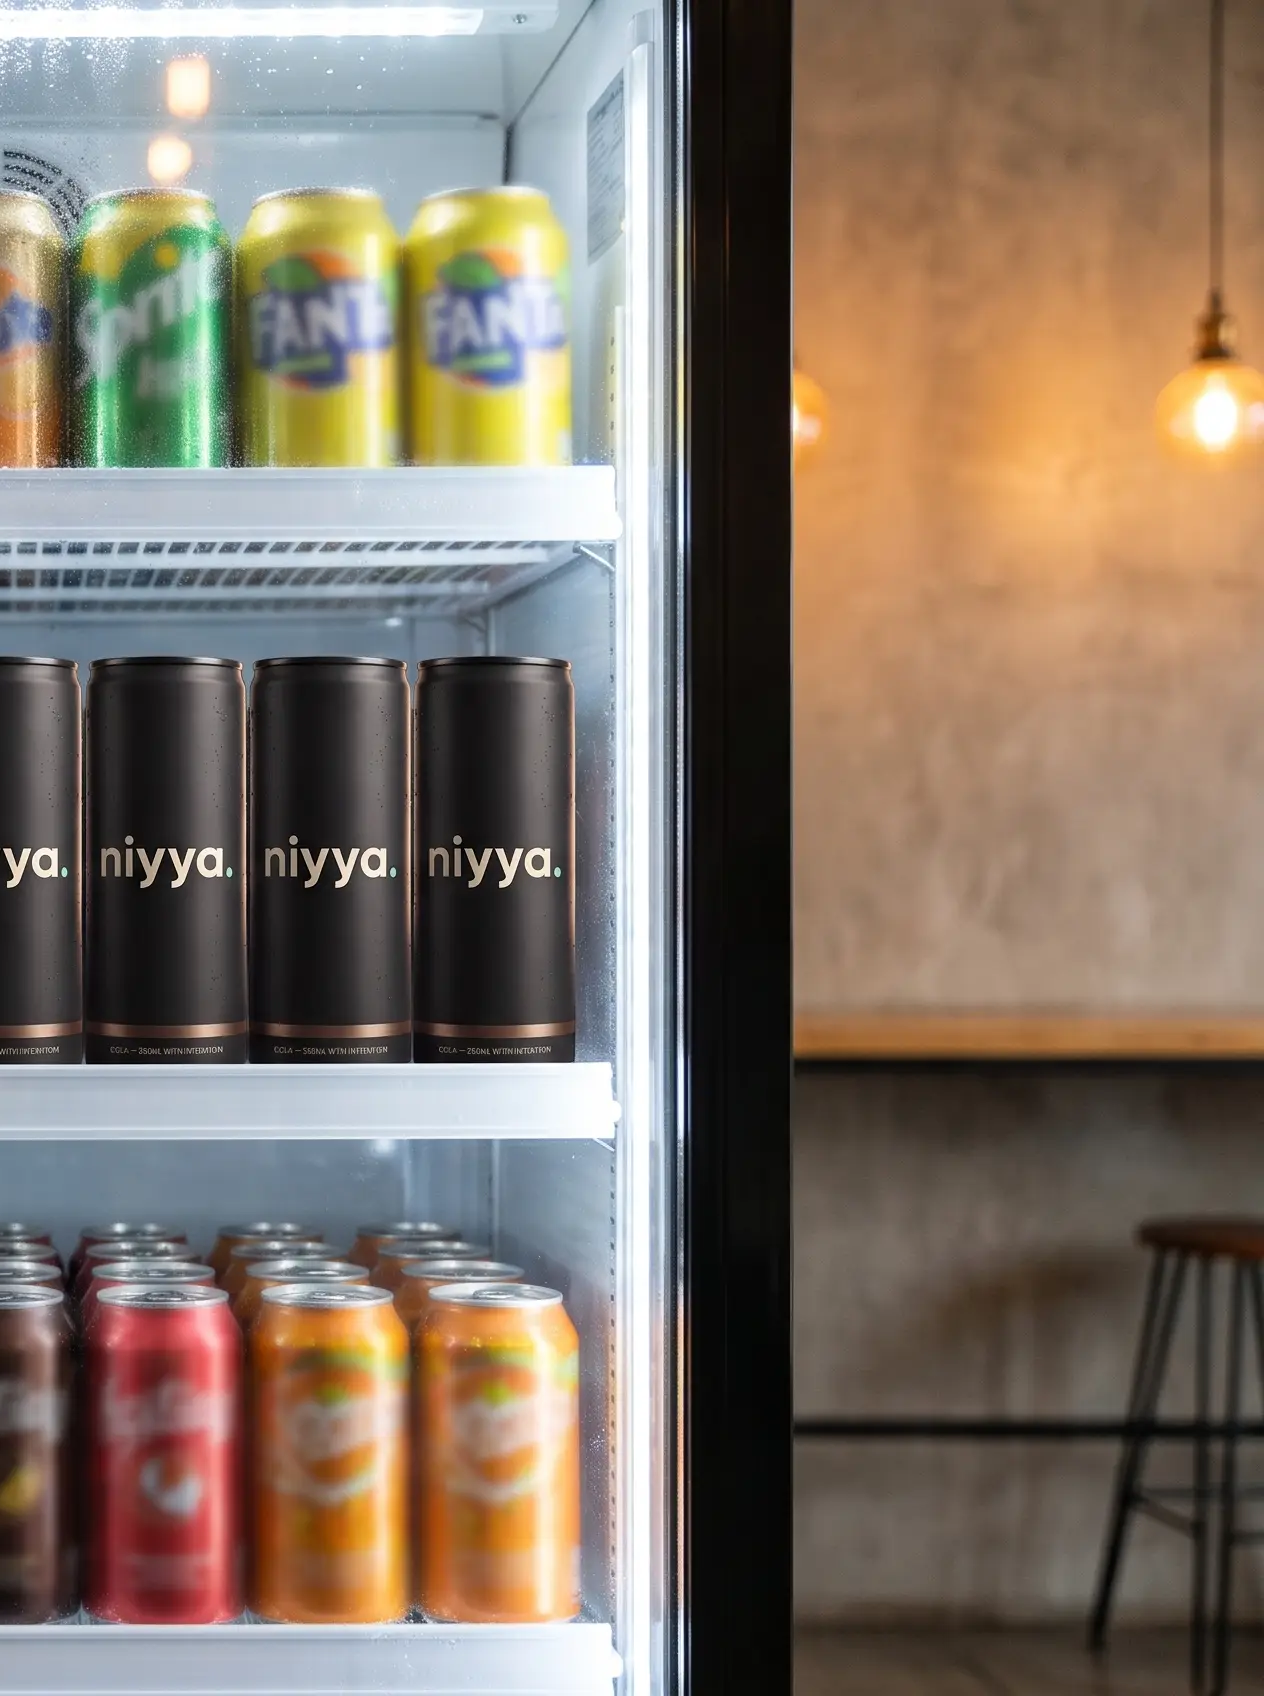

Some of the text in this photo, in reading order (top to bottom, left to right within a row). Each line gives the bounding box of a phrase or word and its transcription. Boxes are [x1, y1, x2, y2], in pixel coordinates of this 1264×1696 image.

[101, 835, 233, 888] niyya.
[265, 835, 396, 888] niyya.
[430, 835, 562, 888] niyya.
